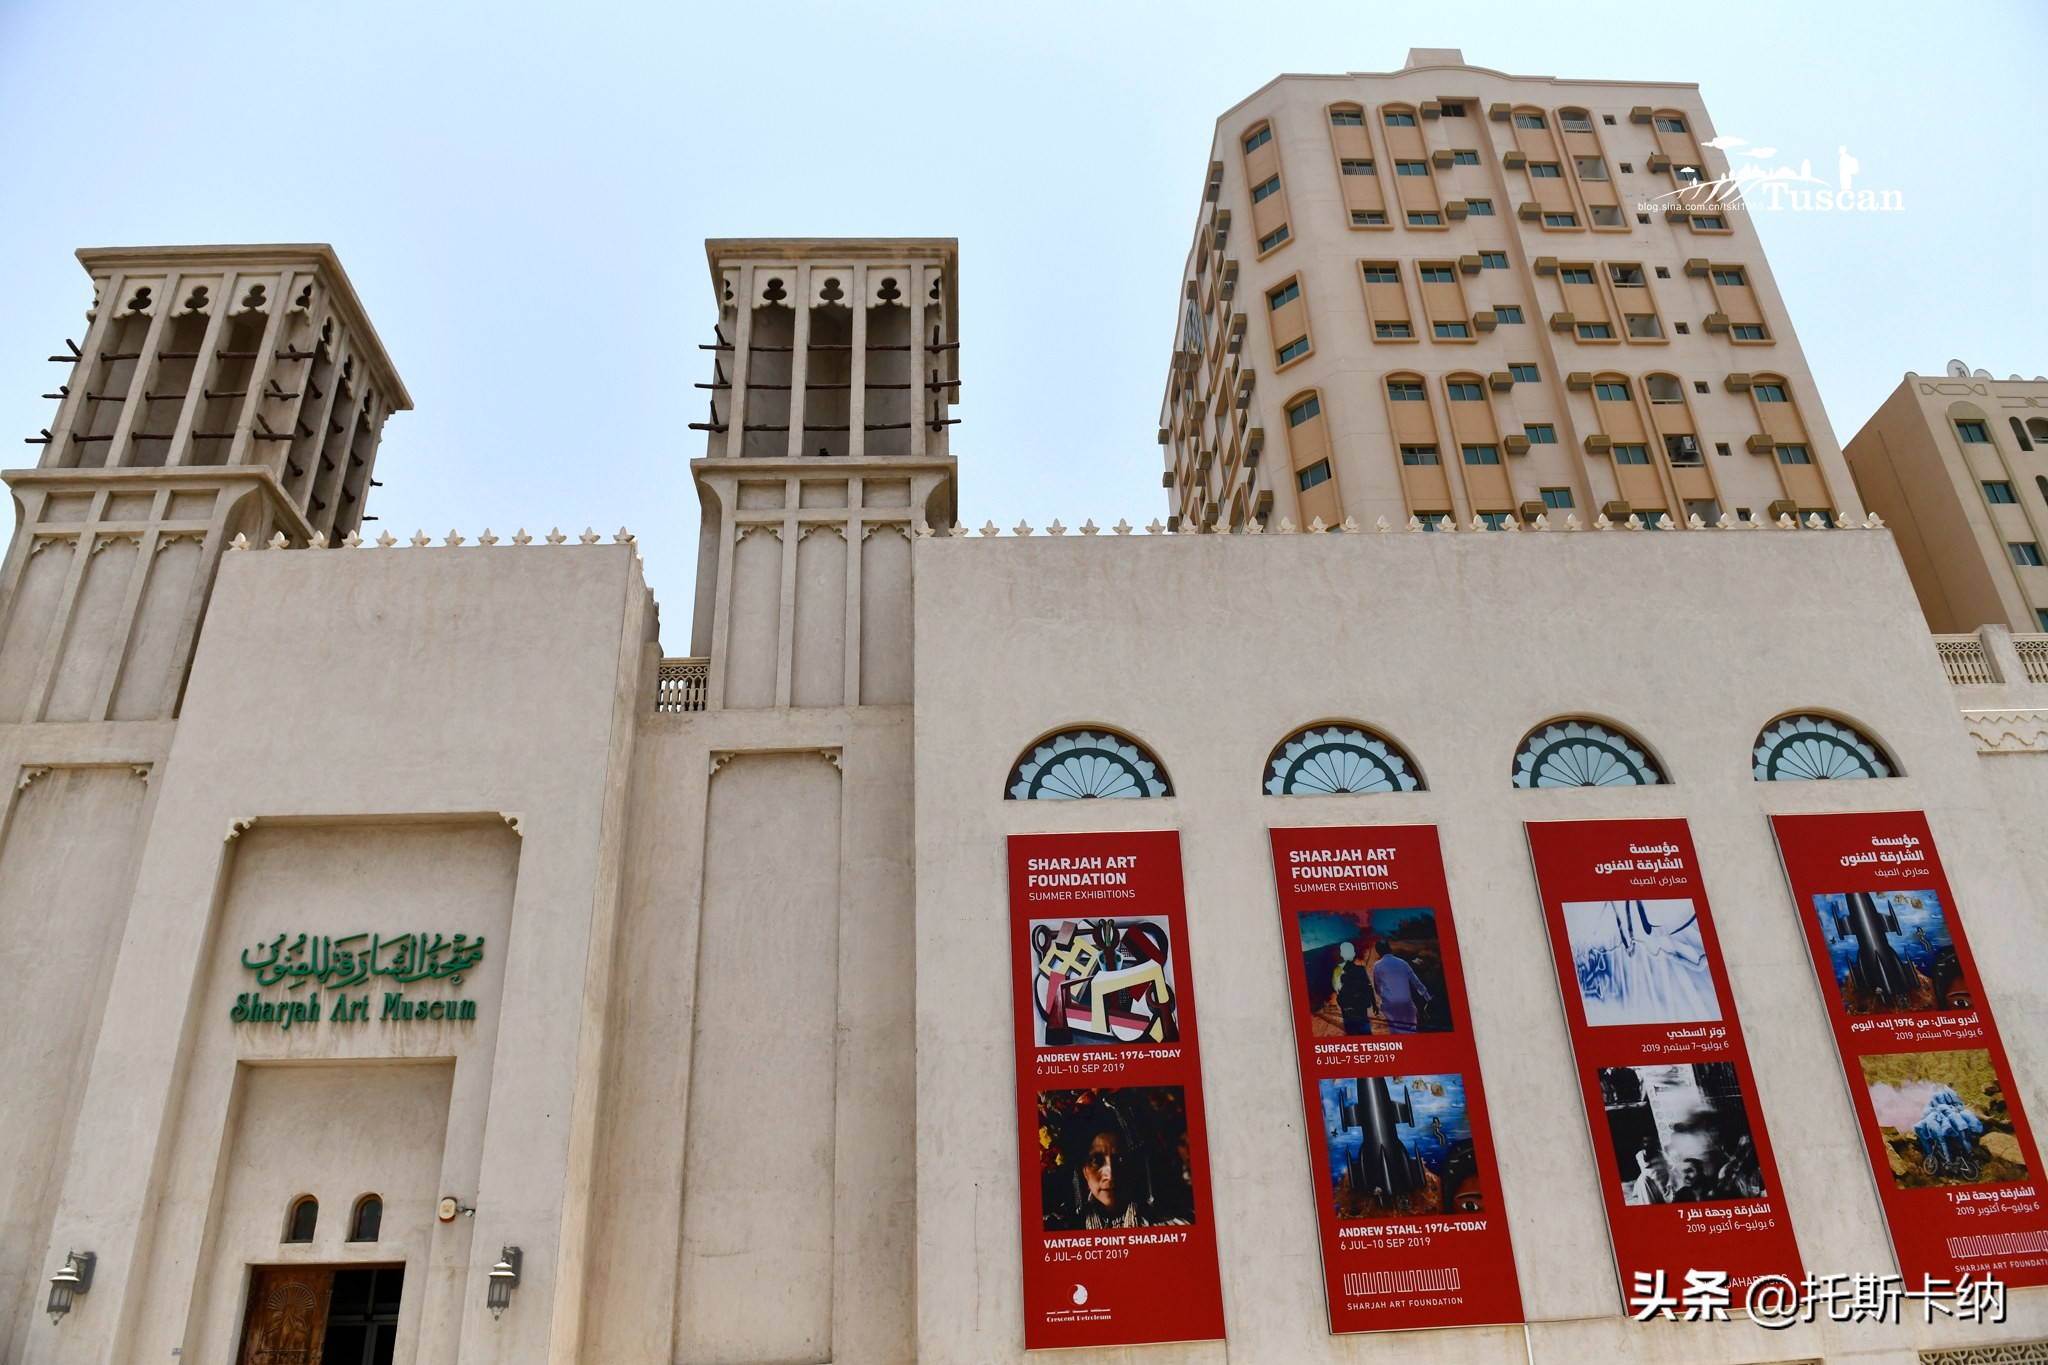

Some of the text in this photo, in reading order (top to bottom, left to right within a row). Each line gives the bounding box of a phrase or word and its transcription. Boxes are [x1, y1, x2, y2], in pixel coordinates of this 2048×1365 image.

[1872, 834, 1919, 848] مؤسسة
[1290, 848, 1396, 862] SHARJAH ART
[1630, 842, 1679, 856] مؤسسة
[1028, 856, 1136, 870] SHARJAH ART
[1840, 849, 1924, 866] الشارقة للفنون
[1292, 865, 1388, 878] FOUNDATION
[1595, 857, 1683, 874] الشارقة للفنون
[1875, 868, 1899, 877] الصيف
[1029, 873, 1126, 887] FOUNDATION
[1630, 877, 1656, 886] الصيف
[1294, 882, 1398, 892] SUMMER EXHIBITIONS
[1029, 890, 1135, 900] SUMMER EXHIBITIONS
[230, 992, 476, 1030] Sharjah Art Museum
[1894, 1018, 1914, 1027] 1976
[1917, 1020, 1929, 1028] من
[1958, 1012, 1979, 1026] أندرو
[1851, 1020, 1874, 1032] اليوم
[1667, 1027, 1726, 1039] توتر السطحي
[1896, 1032, 1913, 1040] 2019
[1917, 1031, 1941, 1041] سبتمبر
[1315, 1042, 1402, 1053] SURFACE TENSION
[1642, 1044, 1660, 1052] 2019
[1664, 1044, 1690, 1053] سبتمبر
[1036, 1053, 1080, 1062] ANDREW
[1083, 1052, 1117, 1061] STAHL:
[1317, 1057, 1321, 1065] 6
[1354, 1055, 1371, 1063] SEP
[1374, 1054, 1395, 1062] 2019
[1082, 1064, 1099, 1072] SEP
[1103, 1063, 1124, 1072] 2019
[1947, 1186, 2035, 1204] الشارقة وجهة نظر 7
[1678, 1203, 1771, 1221] الشارقة وجهة نظر 7
[1956, 1207, 1975, 1215] 2019
[1687, 1224, 1706, 1232] 2019
[1769, 1219, 1774, 1227] 6
[1339, 1226, 1383, 1237] ANDREW
[1386, 1225, 1422, 1235] STAHL:
[1044, 1233, 1186, 1248] VANTAGE POINT SHARJAH 7
[1341, 1242, 1346, 1250] 6
[1386, 1238, 1405, 1247] SEP
[1408, 1237, 1430, 1246] 2019
[1045, 1253, 1050, 1262] 6
[1085, 1250, 1103, 1260] OCT
[1106, 1249, 1128, 1259] 2019
[1955, 1264, 1991, 1273] SHARJAH
[1348, 1302, 1386, 1310] SHARJAH
[1409, 1298, 1462, 1306] FOUNDATION
